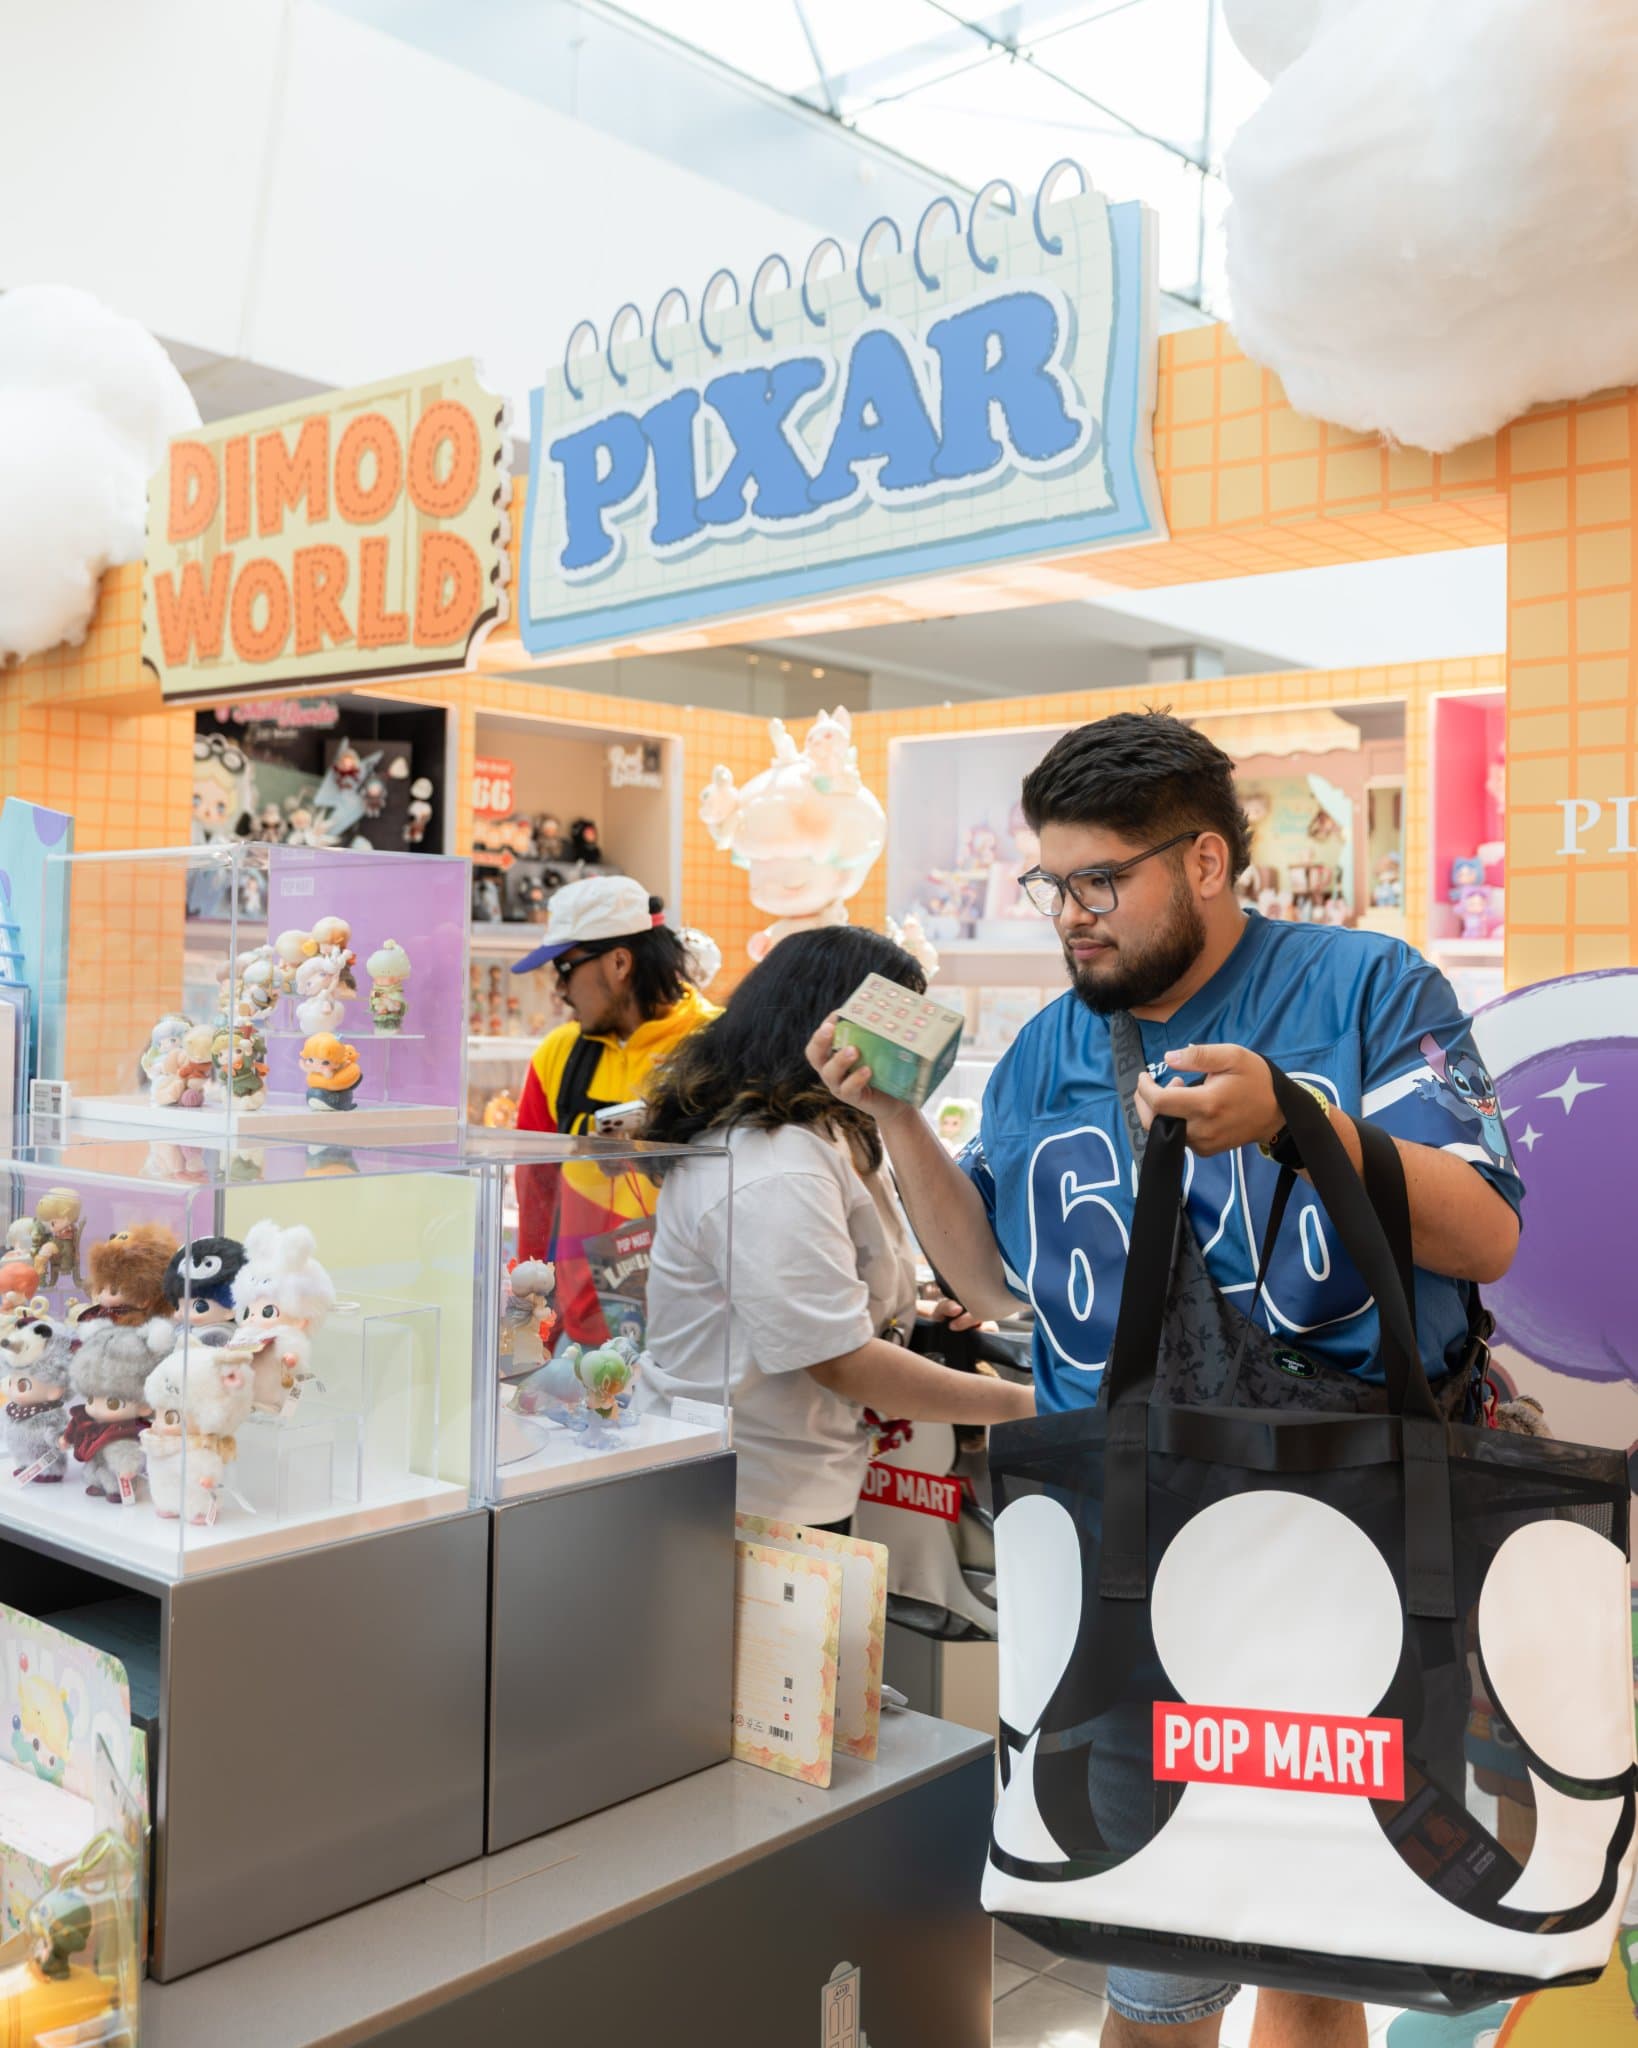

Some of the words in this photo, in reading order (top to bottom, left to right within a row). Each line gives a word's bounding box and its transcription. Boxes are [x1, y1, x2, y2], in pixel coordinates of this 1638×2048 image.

[167, 399, 481, 544] DIMOO
[550, 290, 1082, 571] PIXAR
[153, 532, 483, 668] WORLD
[1555, 796, 1638, 855] PI
[863, 1466, 892, 1497] OP
[895, 1472, 956, 1515] MART
[1165, 1714, 1250, 1774] POP
[1264, 1721, 1391, 1787] MART
